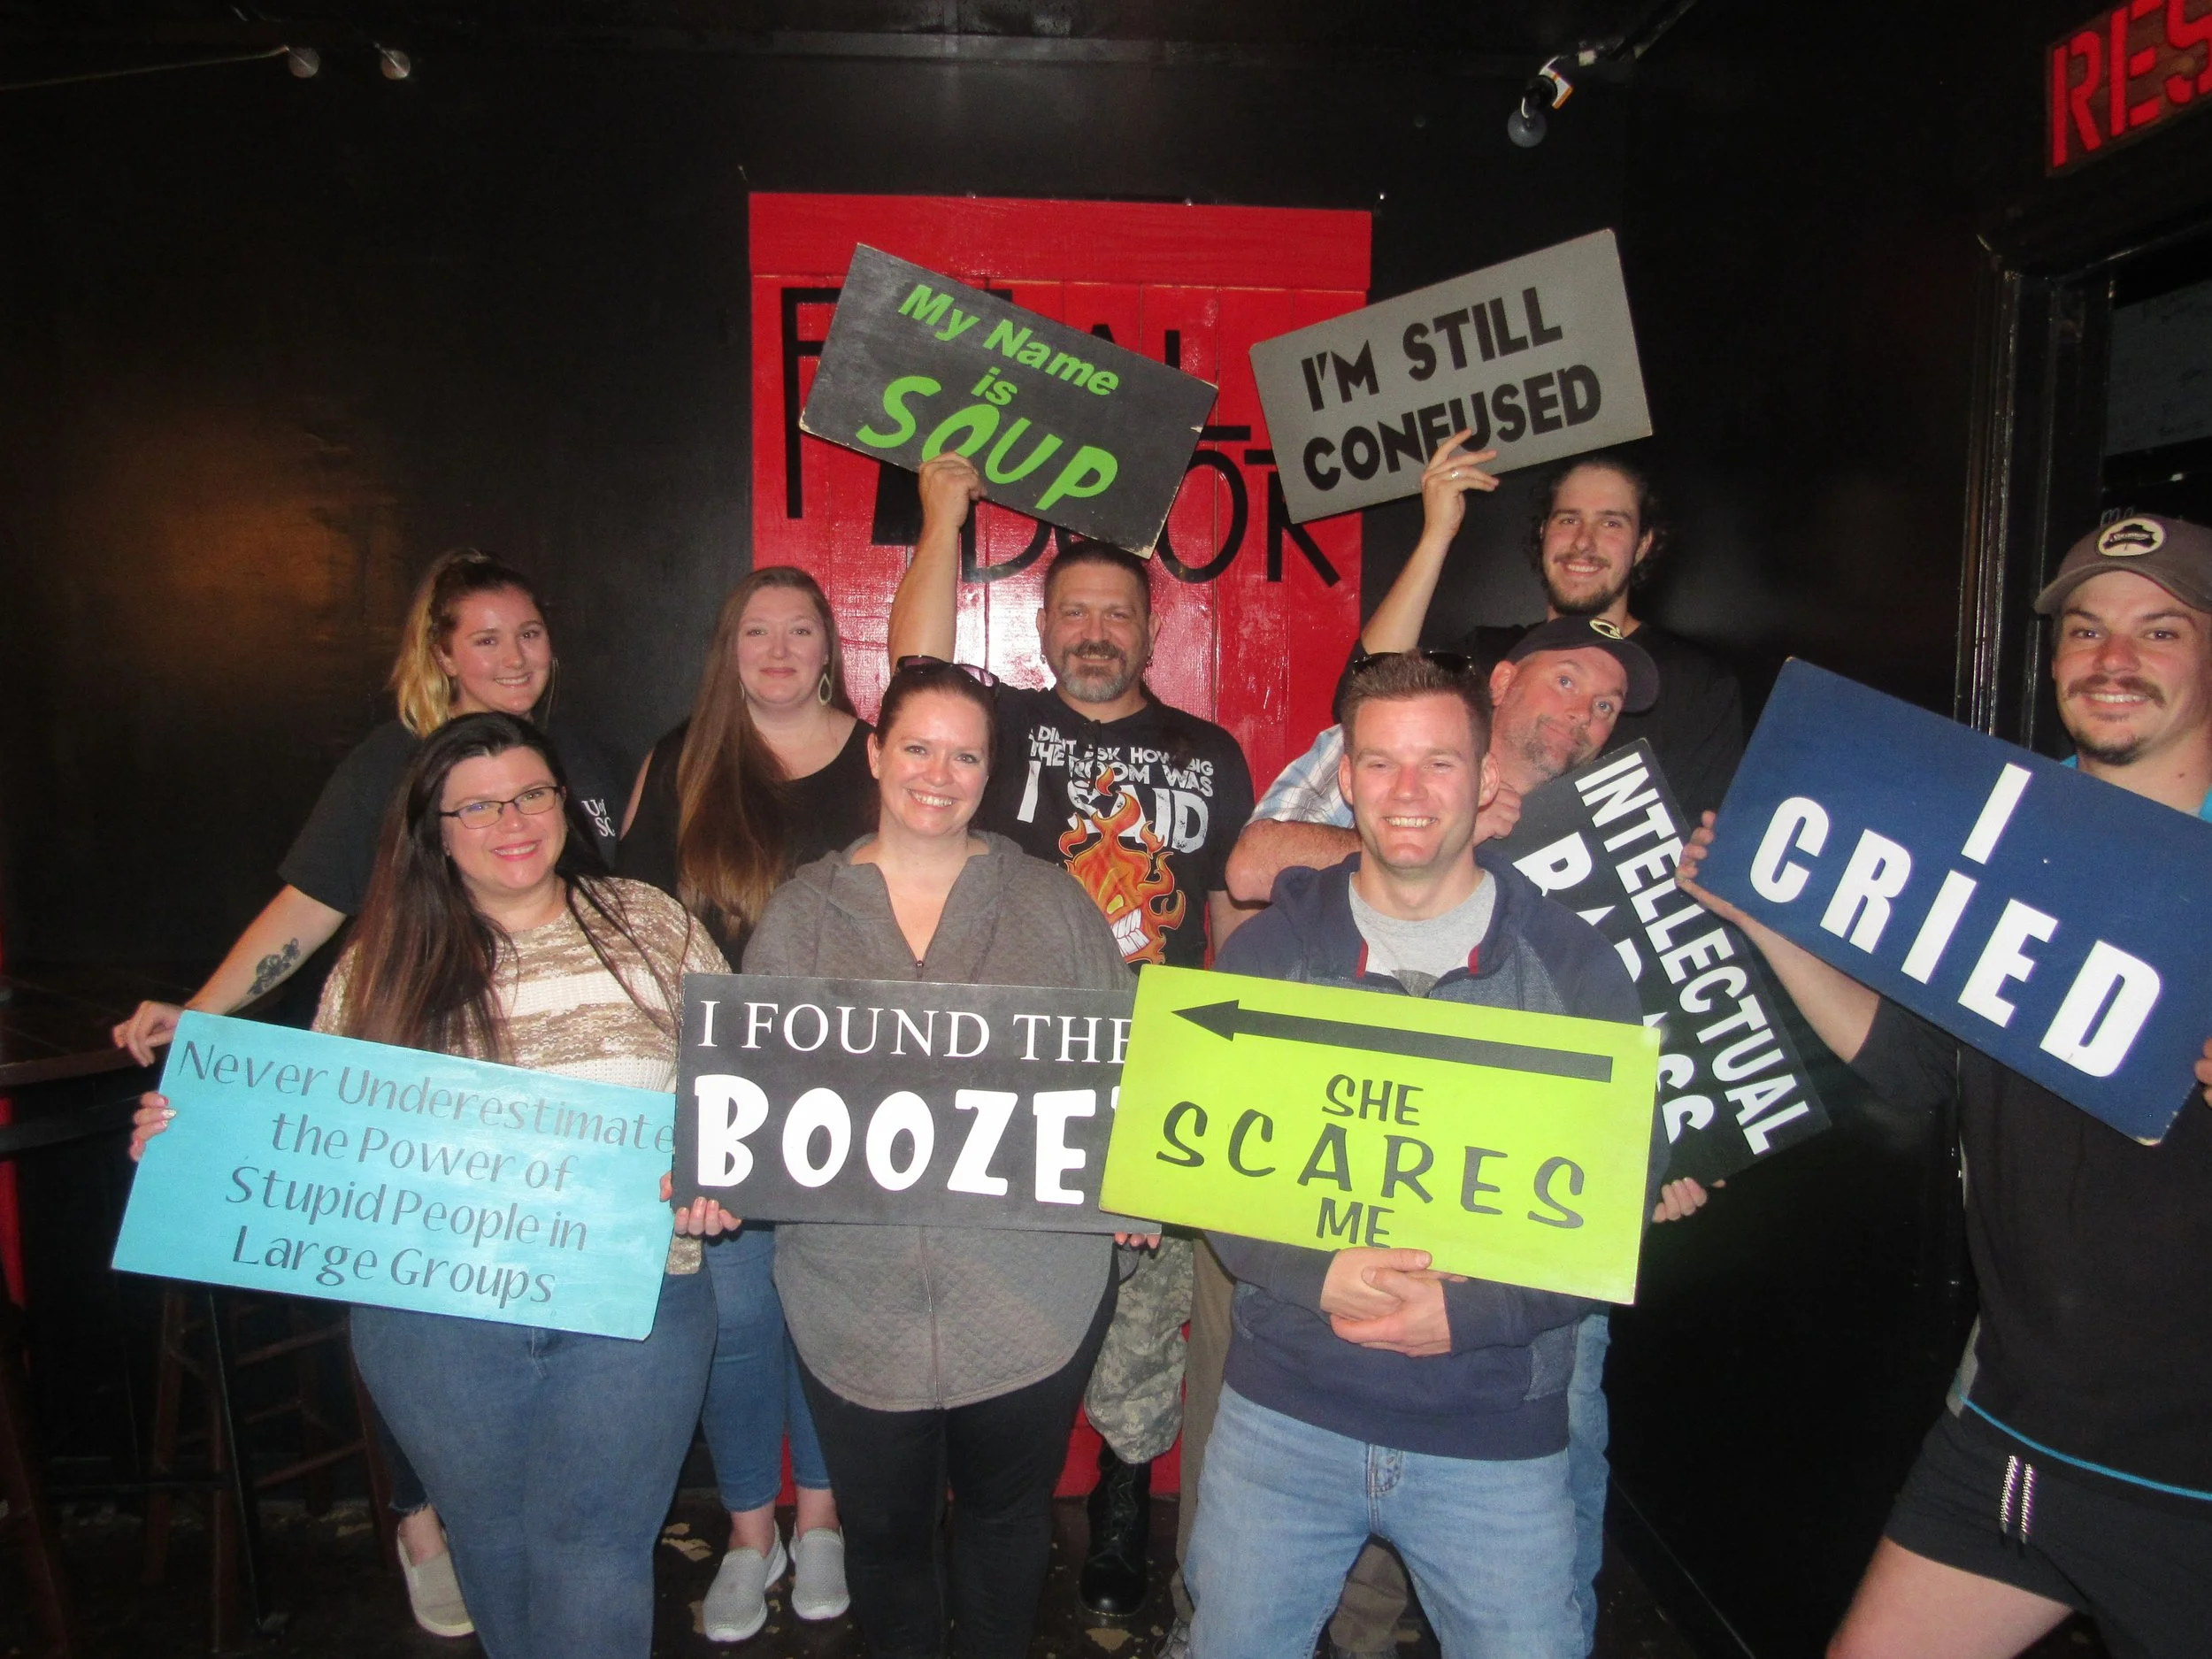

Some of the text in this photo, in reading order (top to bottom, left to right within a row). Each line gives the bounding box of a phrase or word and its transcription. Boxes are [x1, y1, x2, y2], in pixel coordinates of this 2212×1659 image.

[898, 284, 1119, 396] My Name
[970, 366, 1018, 405] is
[1301, 287, 1563, 412] I'M STILL
[856, 375, 1118, 511] SOUP
[1303, 364, 1601, 491] CONFUSED
[1017, 760, 1041, 824] I
[1162, 764, 1214, 797] WAS
[1961, 763, 2032, 865] I
[1574, 752, 1809, 1156] INTELLECTUAL
[1749, 796, 2162, 1078] CRIED
[697, 1000, 1133, 1064] I FOUND THE
[178, 1040, 675, 1153] Never Underestimate
[694, 1073, 1121, 1206] BOOZE
[1322, 1073, 1424, 1126] SHE
[272, 1112, 580, 1192] the Power of
[1156, 1101, 1585, 1229] SCARES
[226, 1164, 588, 1251] Stupid People in
[1316, 1198, 1395, 1250] ME
[233, 1225, 557, 1310] Large Groups
